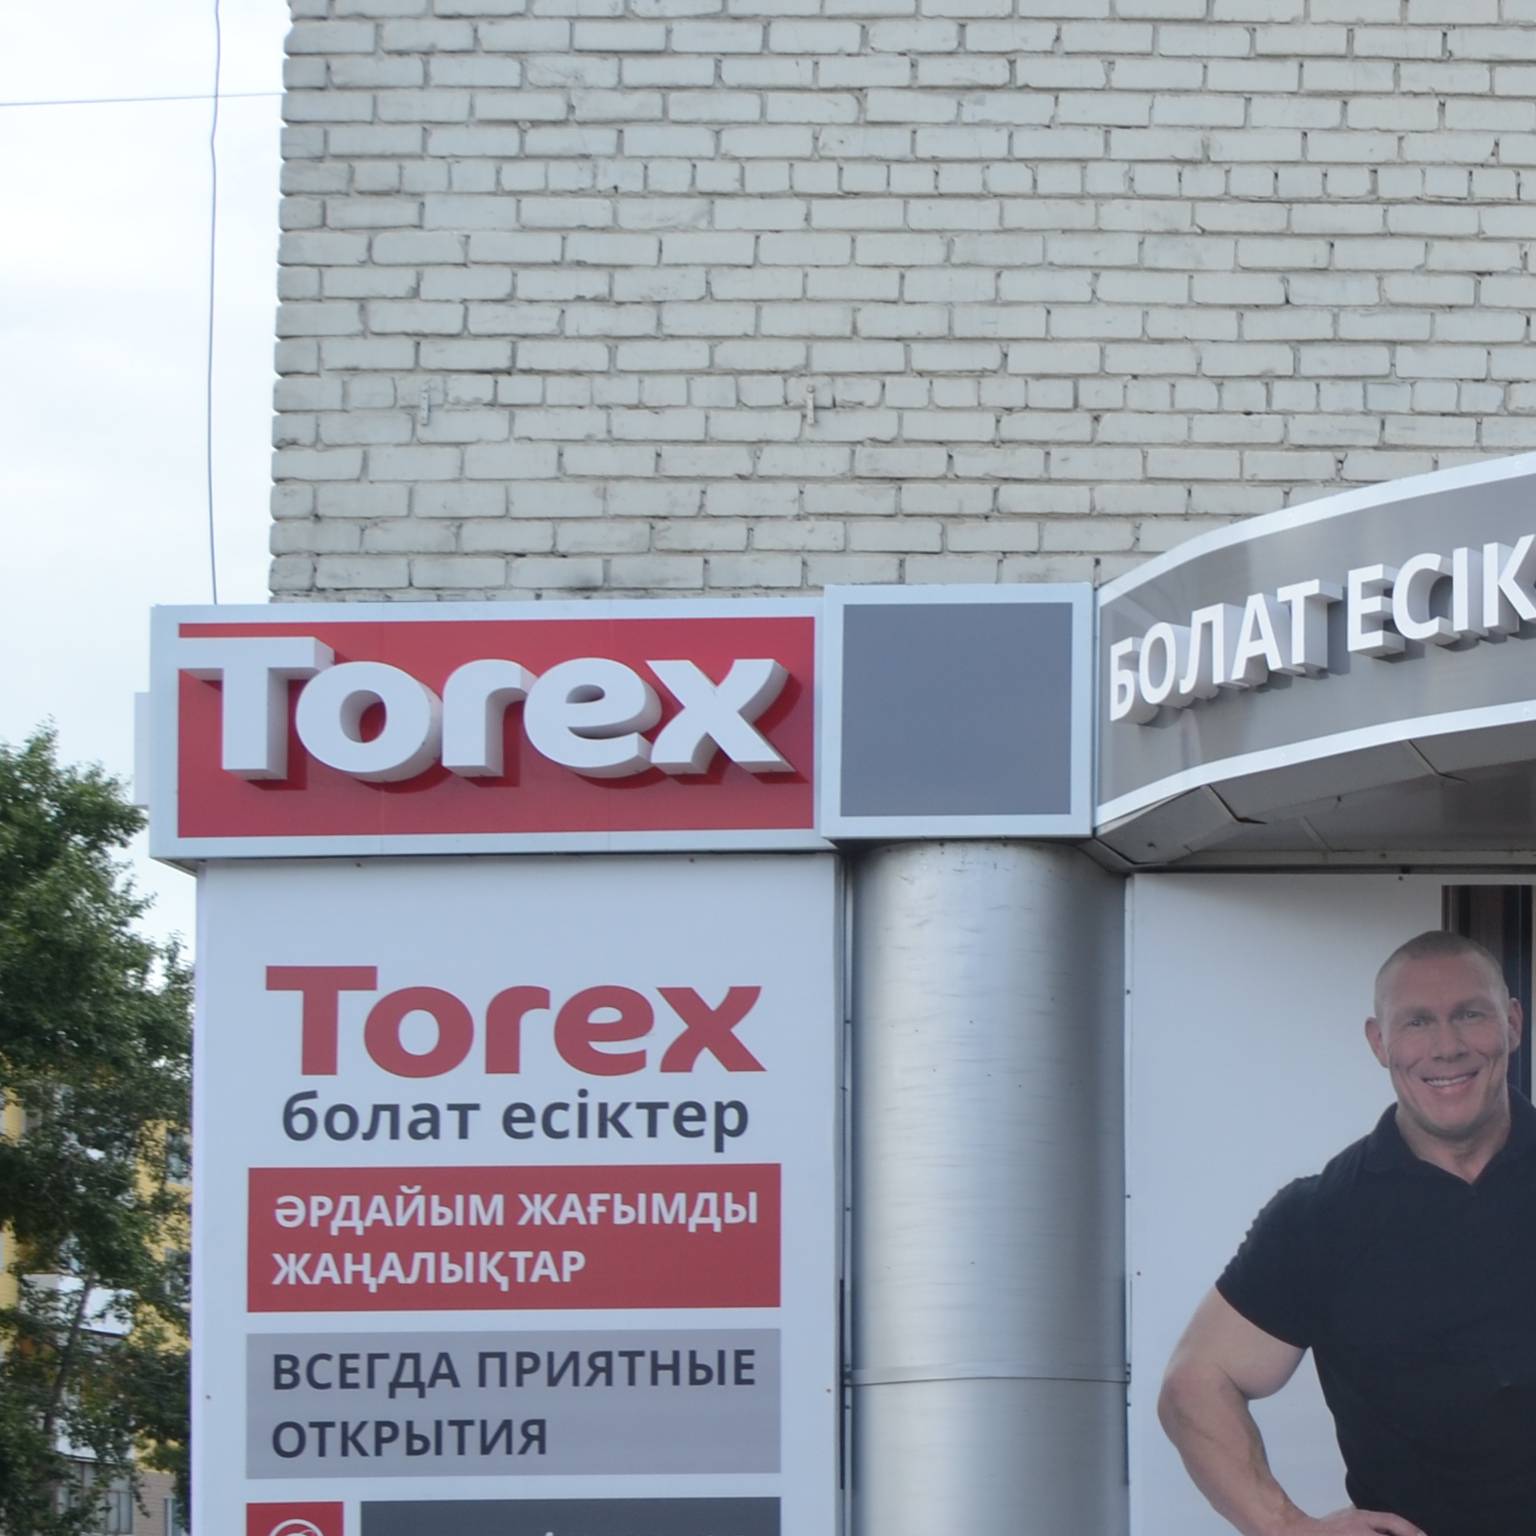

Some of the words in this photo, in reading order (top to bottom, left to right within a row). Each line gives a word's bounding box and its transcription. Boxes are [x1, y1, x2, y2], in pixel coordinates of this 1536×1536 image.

[1110, 579, 1342, 725] БОЛАТ
[178, 636, 796, 782] Torex
[265, 966, 768, 1078] Torex
[281, 1091, 481, 1141] болат
[501, 1089, 750, 1153] есіктер
[274, 1186, 504, 1236] ӘРДАЙЫМ
[517, 1190, 759, 1232] ЖАҒЫМДЫ
[271, 1251, 586, 1293] ЖАҢАЛЫҚТАР
[272, 1351, 461, 1399] ВСЕГДА
[477, 1349, 757, 1389] ПРИЯТНЫЕ
[271, 1418, 548, 1458] ОТКРЫТИЯ
